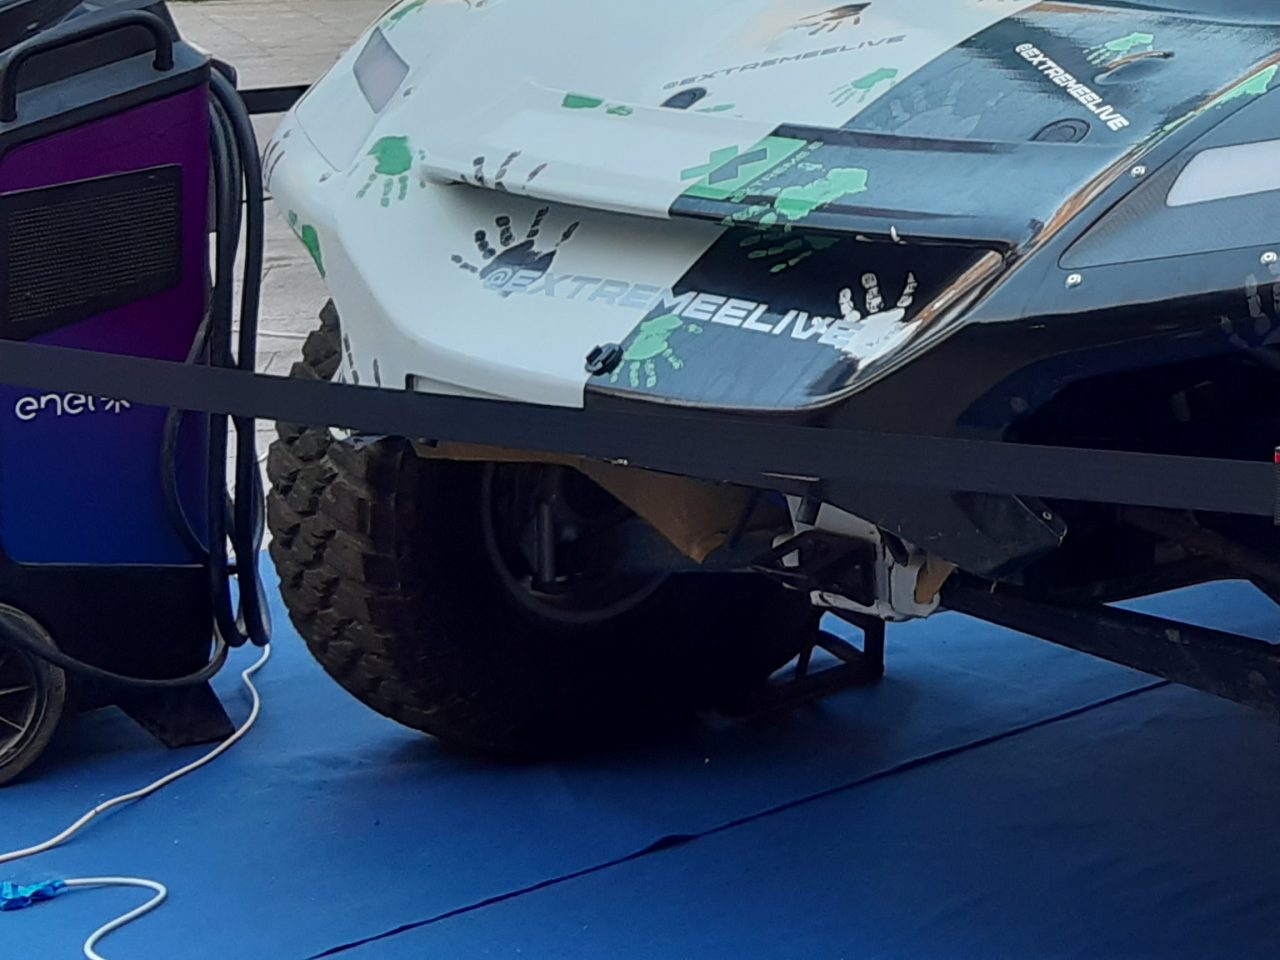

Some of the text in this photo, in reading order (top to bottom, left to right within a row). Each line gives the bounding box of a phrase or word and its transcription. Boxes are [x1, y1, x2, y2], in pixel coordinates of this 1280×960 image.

[662, 34, 907, 91] @EXTREMEELIVE
[1015, 42, 1131, 133] @EXTREMEELIVE
[484, 266, 862, 348] @EXTREMEELIVE
[15, 392, 96, 420] enel
